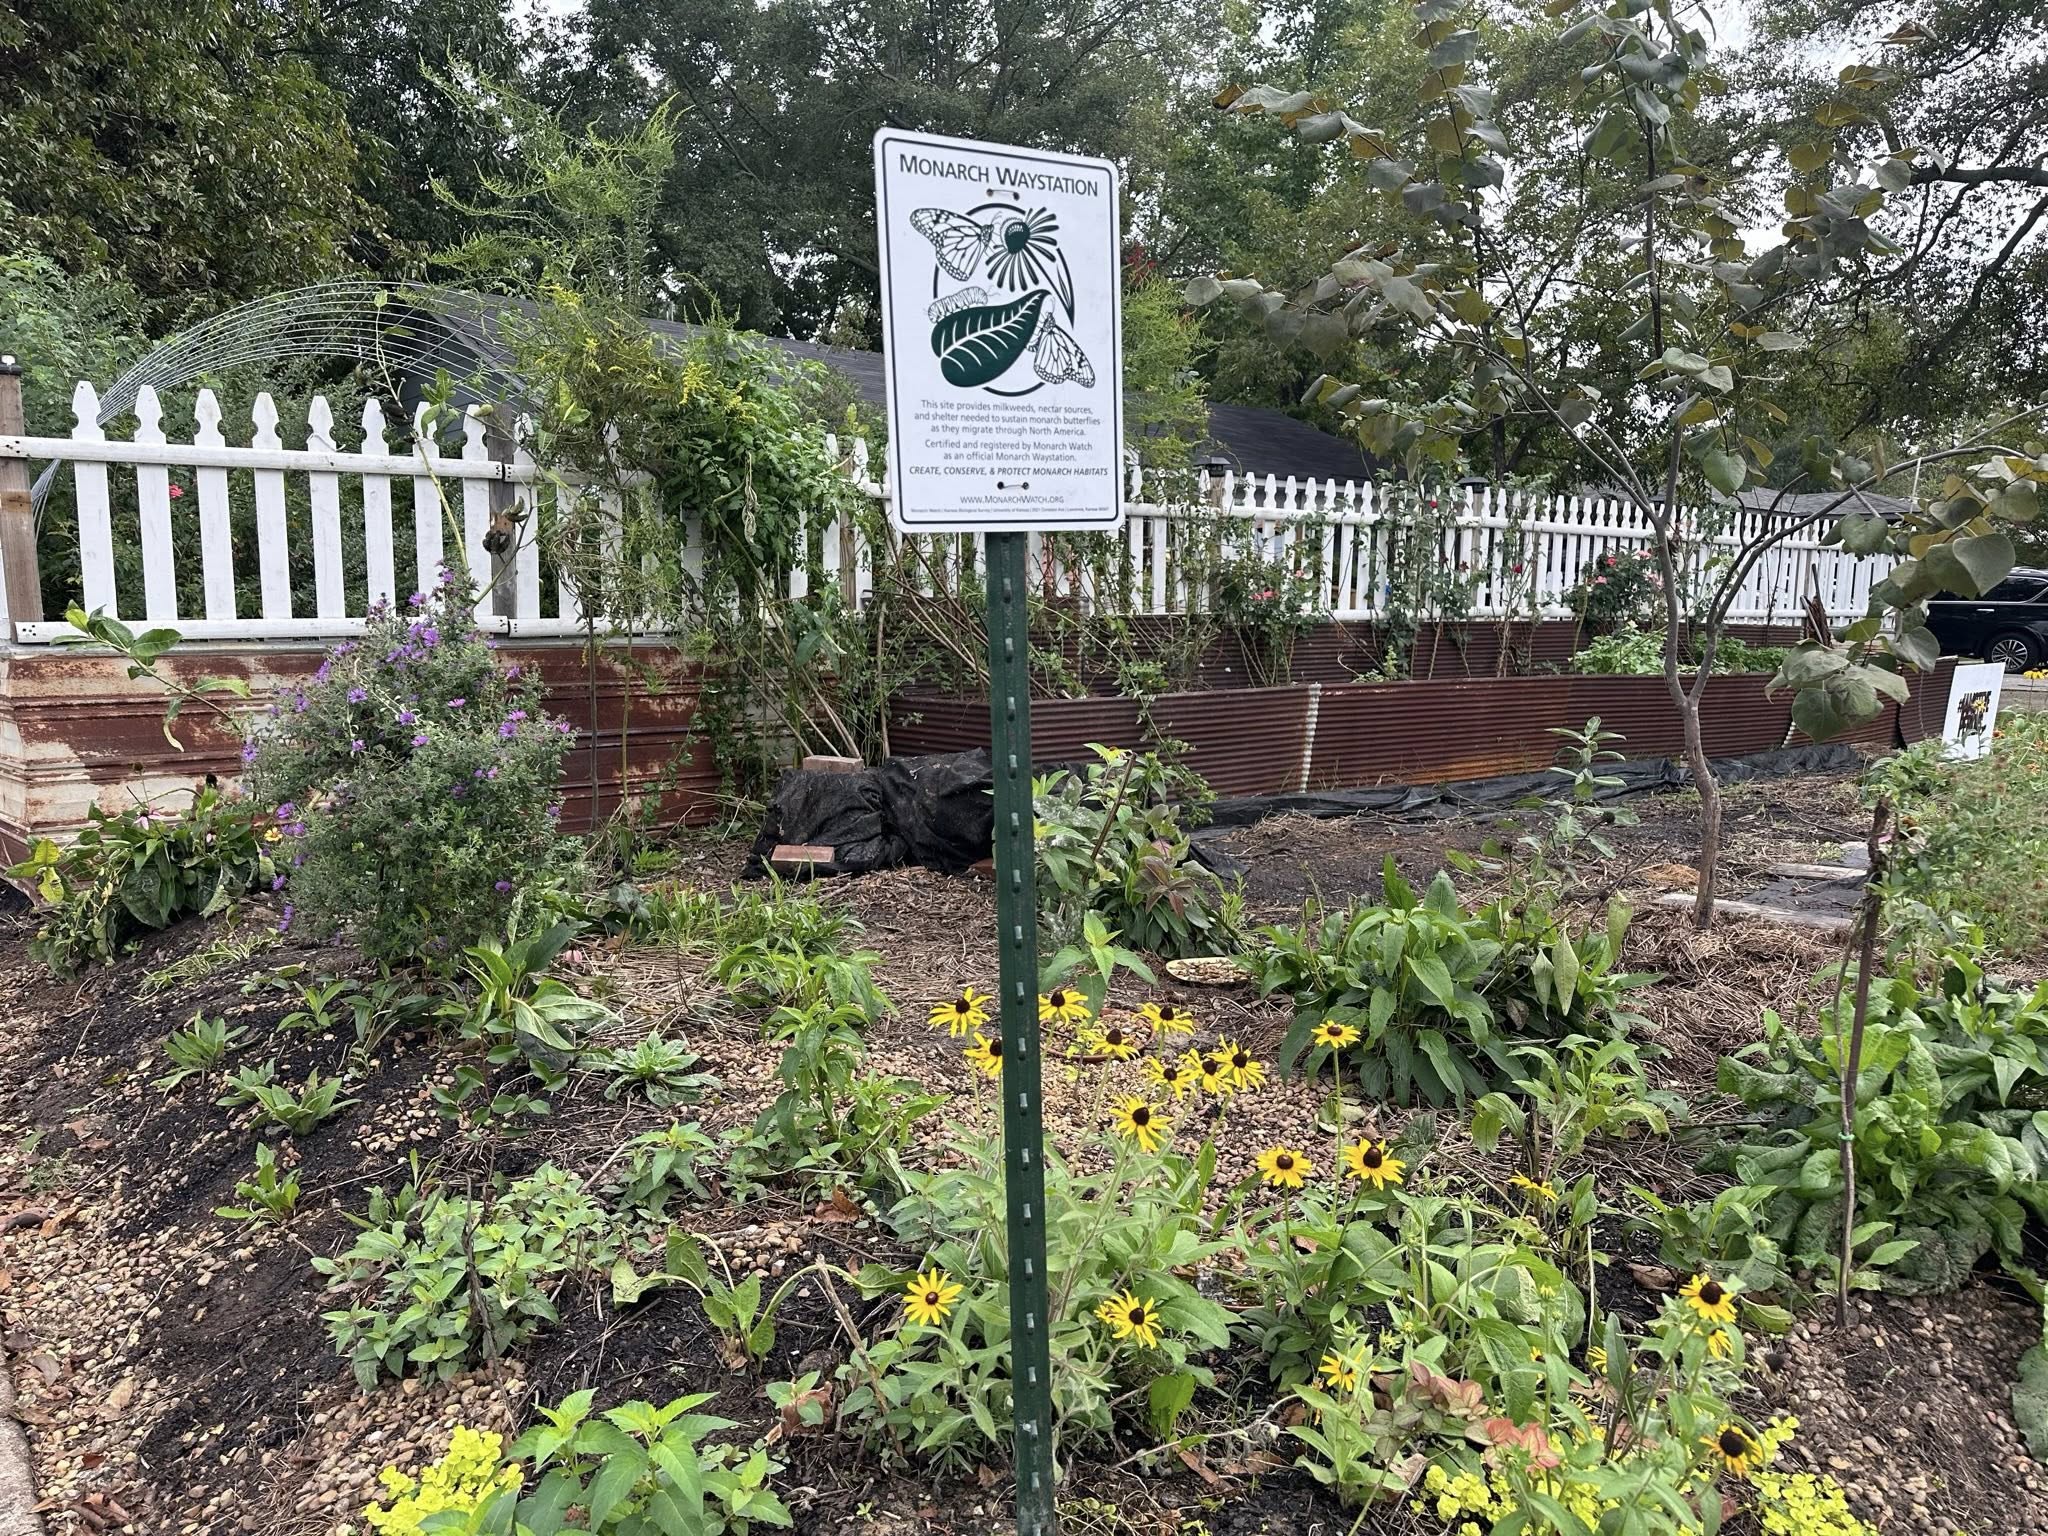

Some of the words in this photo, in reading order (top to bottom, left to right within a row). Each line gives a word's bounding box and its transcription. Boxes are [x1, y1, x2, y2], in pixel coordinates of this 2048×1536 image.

[899, 153, 989, 183] MONARCH
[996, 166, 1098, 197] WAYSTATION
[921, 399, 938, 409] This
[940, 400, 954, 410] site
[956, 402, 991, 412] provides
[993, 402, 1036, 413] milkweeds,
[1038, 405, 1062, 413] nectar
[1064, 406, 1093, 415] sources,
[914, 412, 930, 421] and
[931, 411, 958, 421] shelter
[961, 413, 990, 422] needed
[1001, 415, 1028, 423] sustain
[1029, 415, 1062, 424] monarch
[1063, 416, 1100, 425] butterflies
[941, 424, 960, 435] they
[962, 425, 993, 435] migrate
[995, 425, 1027, 436] through
[1029, 426, 1052, 435] North
[1053, 427, 1086, 436] America.
[925, 439, 960, 448] Certified
[962, 440, 978, 449] and
[981, 440, 1020, 451] registered
[1022, 441, 1031, 451] by
[1033, 441, 1067, 450] Monarch
[1069, 442, 1093, 451] Watch
[966, 451, 994, 460] official
[996, 452, 1030, 461] Monarch
[1032, 453, 1077, 463] Waystation.
[909, 466, 941, 475] CREATE,
[943, 466, 987, 476] CONSERVE,
[989, 467, 995, 475] &
[997, 467, 1031, 476] PROTECT
[1032, 467, 1072, 476] MONARCH
[1073, 467, 1108, 476] HABITATS
